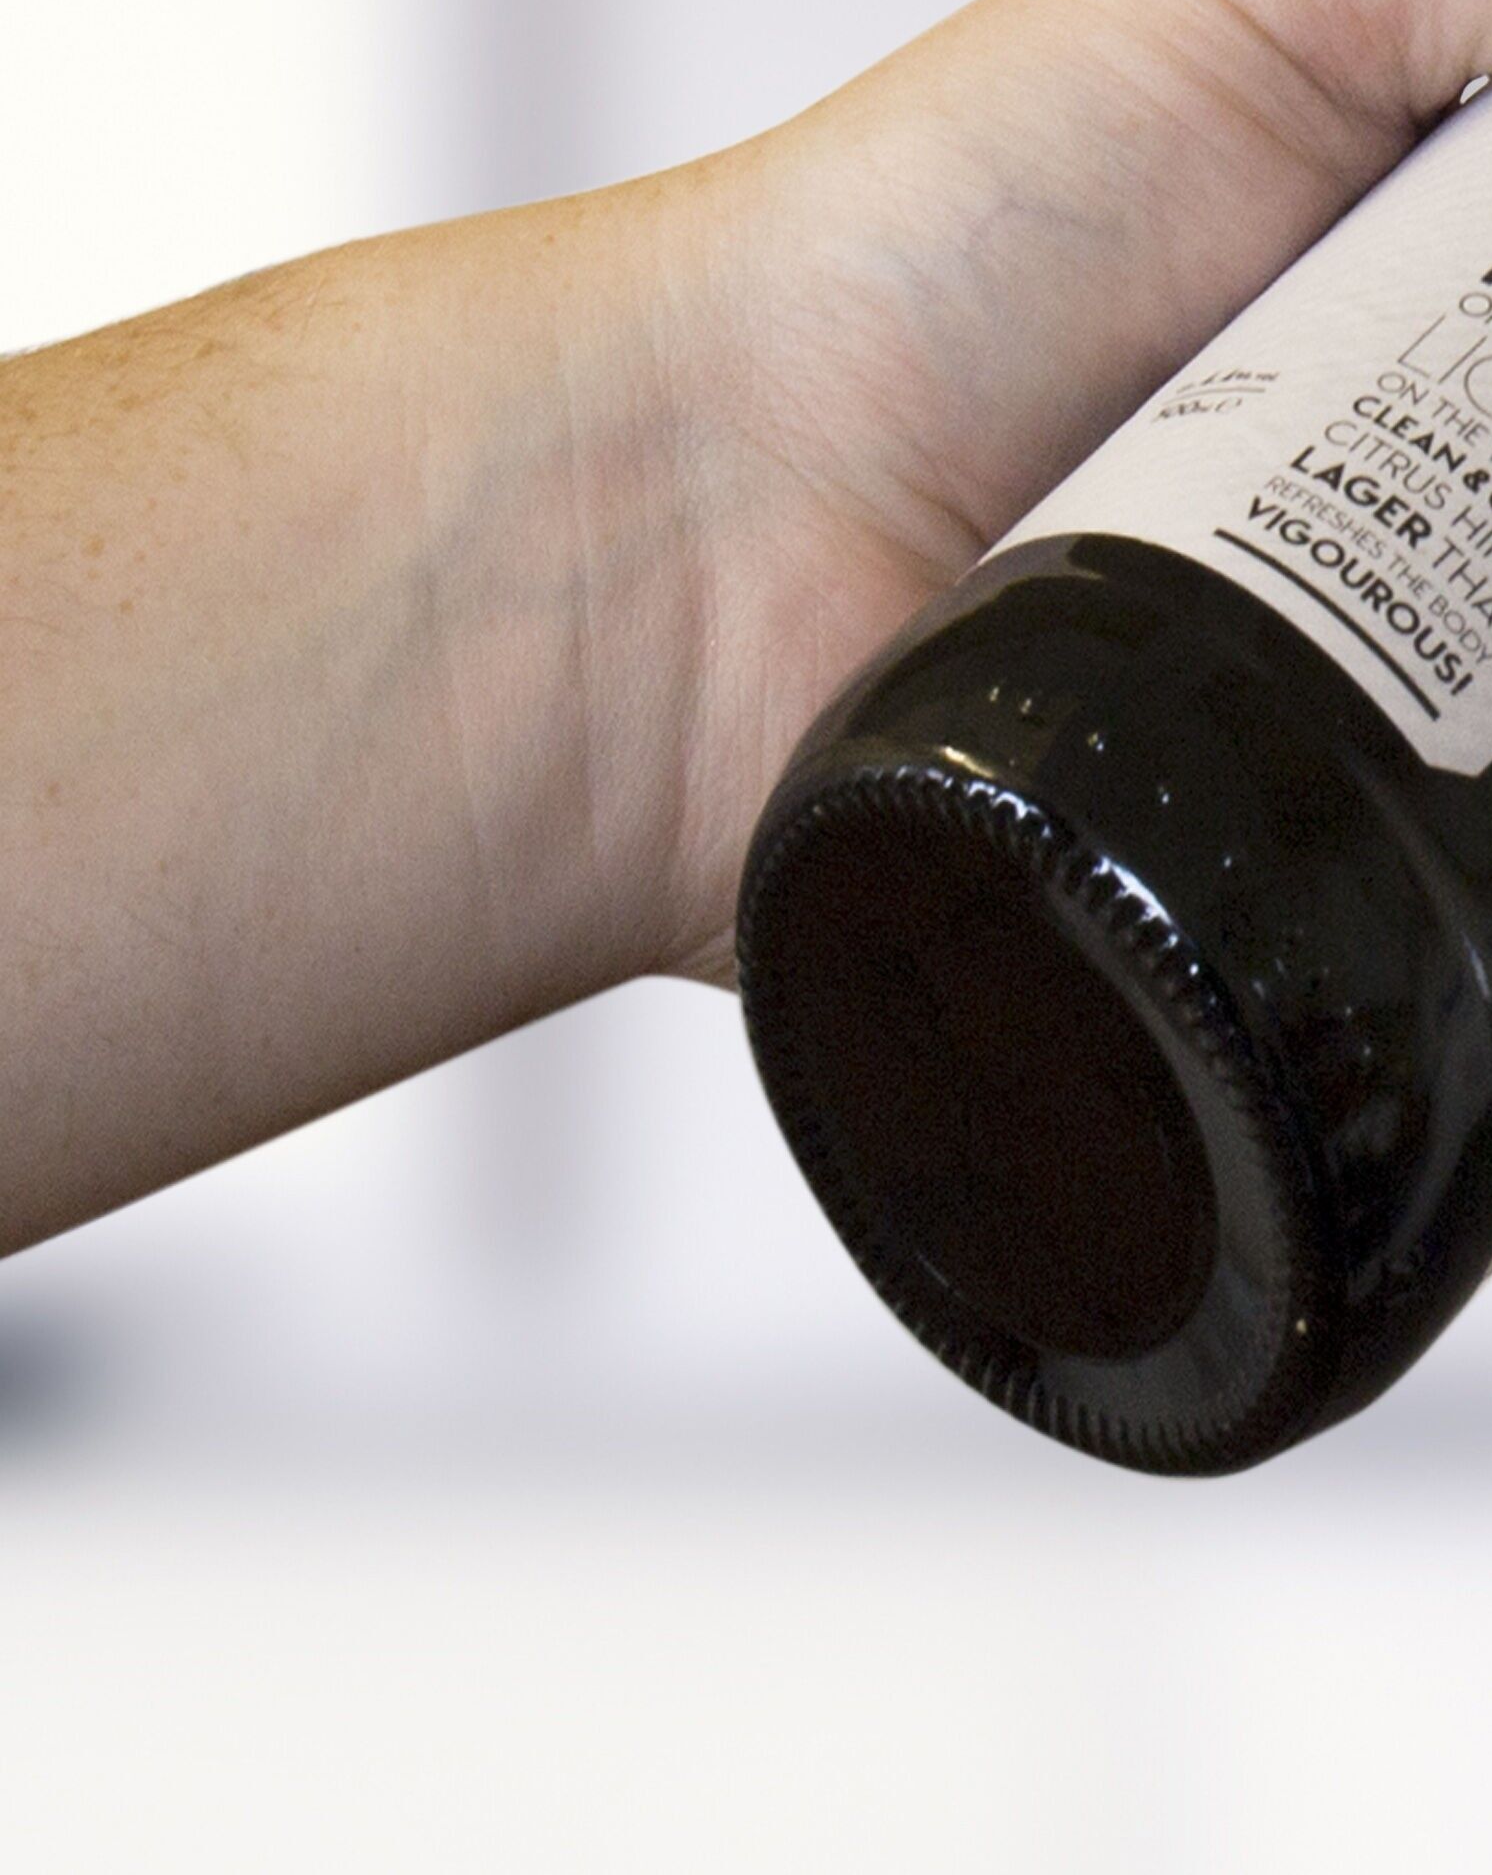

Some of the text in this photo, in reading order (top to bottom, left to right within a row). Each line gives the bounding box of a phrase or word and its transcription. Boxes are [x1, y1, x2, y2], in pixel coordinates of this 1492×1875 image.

[1351, 394, 1468, 473] CLEAN
[1377, 371, 1430, 406] ON
[1432, 396, 1490, 448] THE
[1289, 445, 1433, 550] LAGER
[1323, 419, 1453, 510] CITRUS
[1264, 474, 1388, 560] REFRESHES
[1387, 555, 1434, 601] THE
[1248, 494, 1475, 696] VIGOUROUS!
